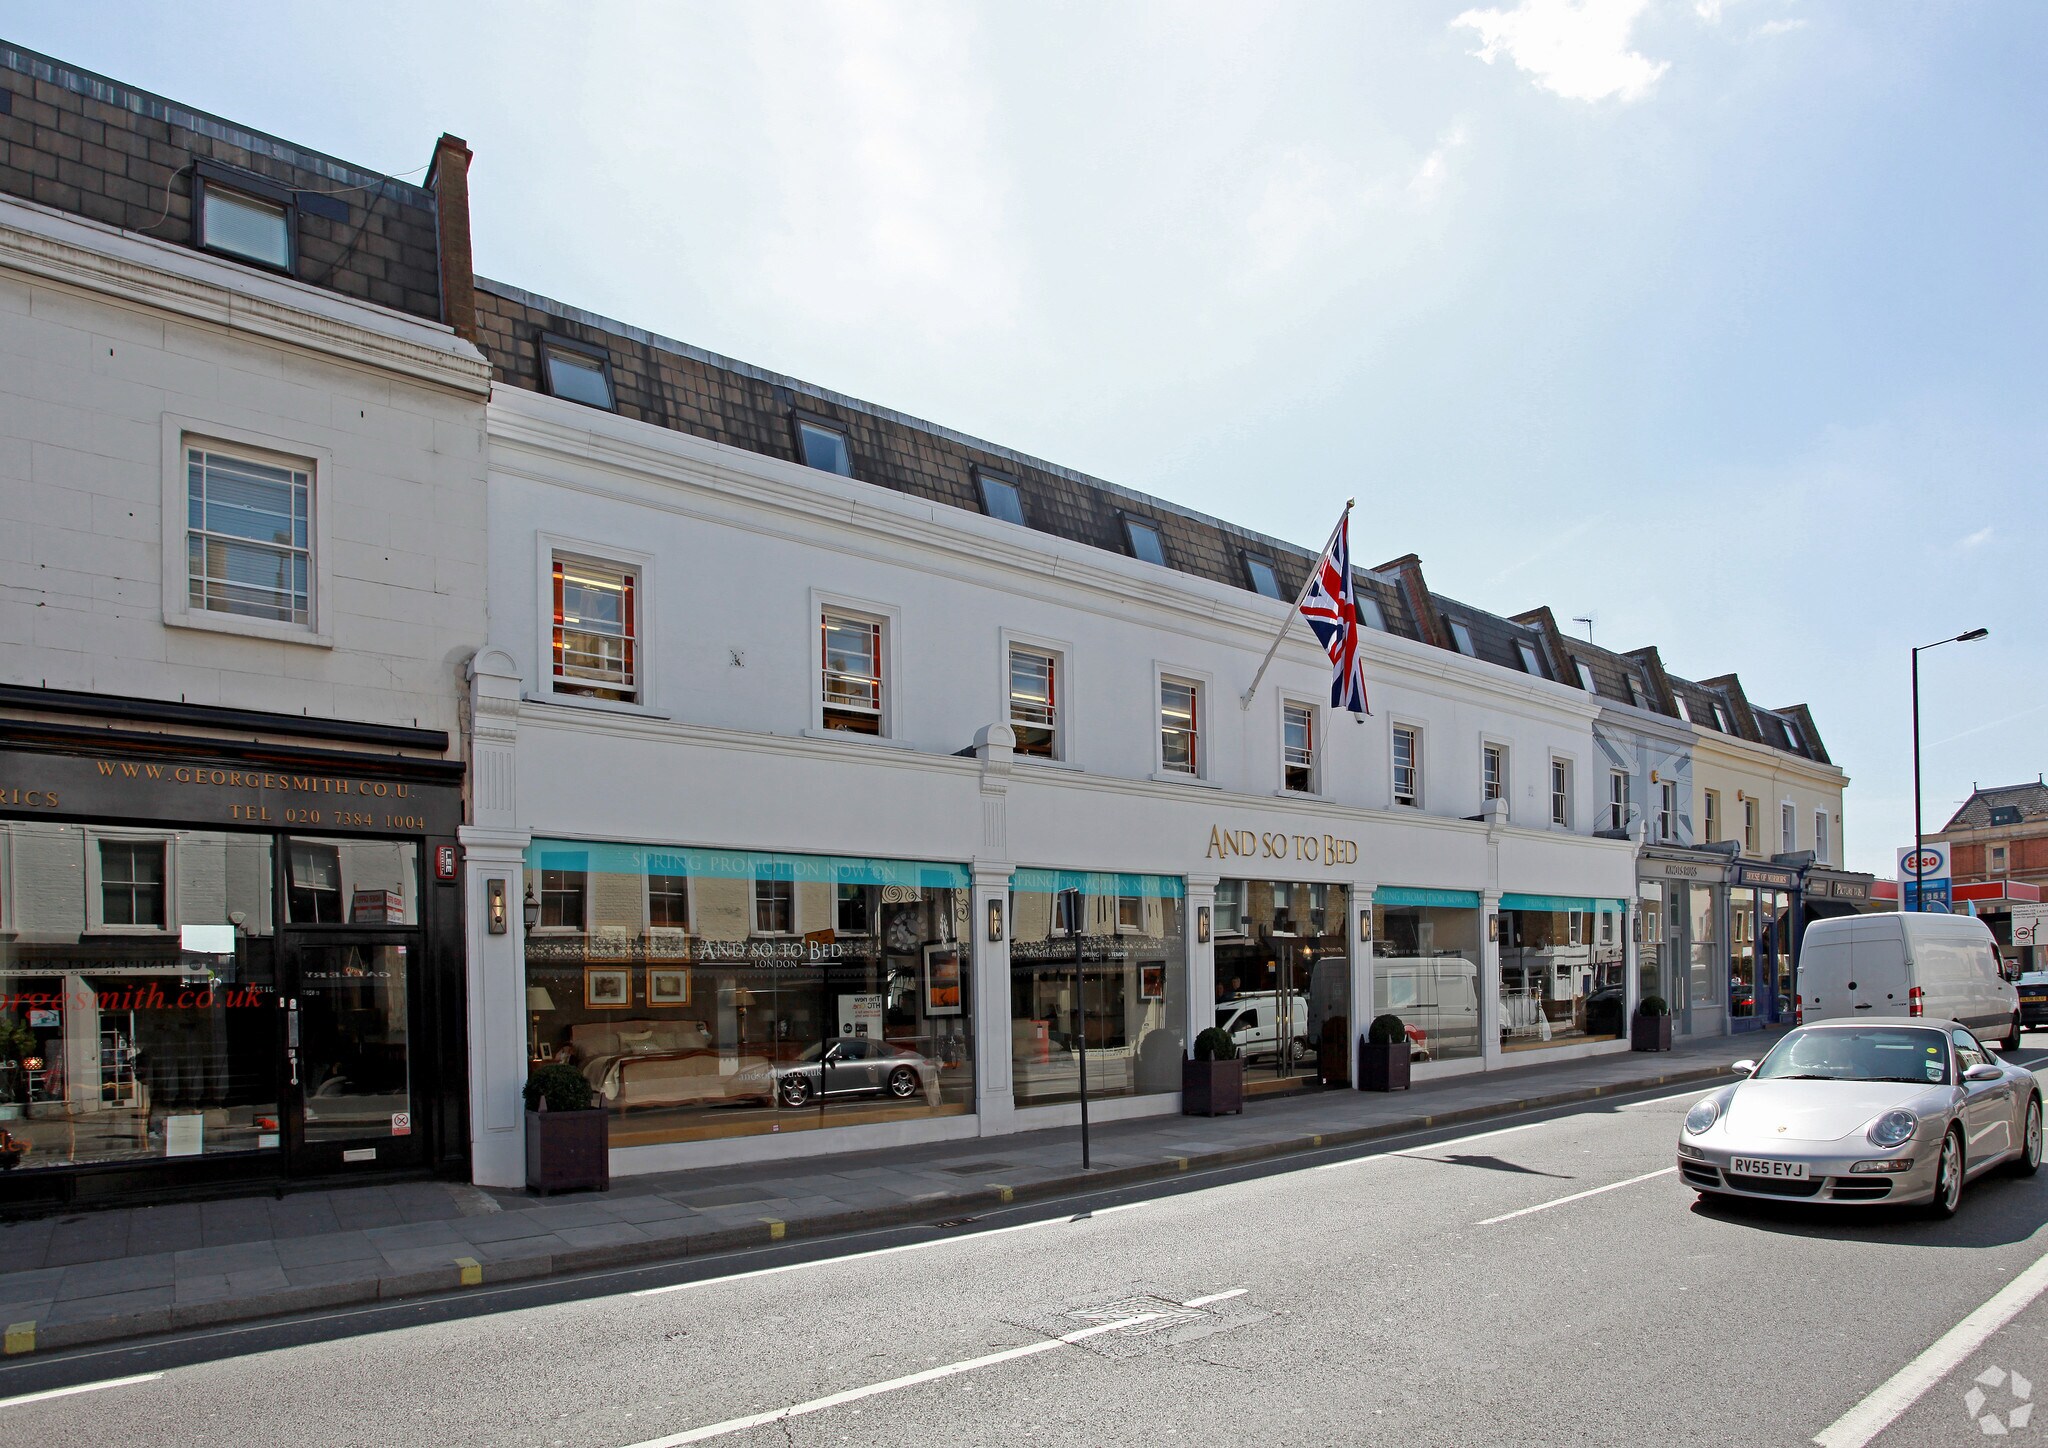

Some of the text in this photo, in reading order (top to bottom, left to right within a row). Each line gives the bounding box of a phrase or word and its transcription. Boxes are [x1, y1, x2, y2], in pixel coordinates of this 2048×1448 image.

[229, 804, 425, 830] TEL 020 7384 1004
[1261, 831, 1288, 859] SO
[1292, 835, 1320, 862] TO
[445, 850, 453, 873] LEE
[631, 852, 897, 880] SPRING PROMOTION NOW ON
[1907, 857, 1937, 869] Eso
[1011, 873, 1054, 888] SPRING
[1060, 876, 1129, 892] PROMOTION
[1133, 879, 1161, 892] NOW
[1402, 891, 1445, 903] PROMOTION
[751, 942, 773, 958] SO
[780, 942, 803, 959] TO
[754, 959, 797, 968] LONDON
[1735, 1158, 1803, 1177] RV55 EYJ
